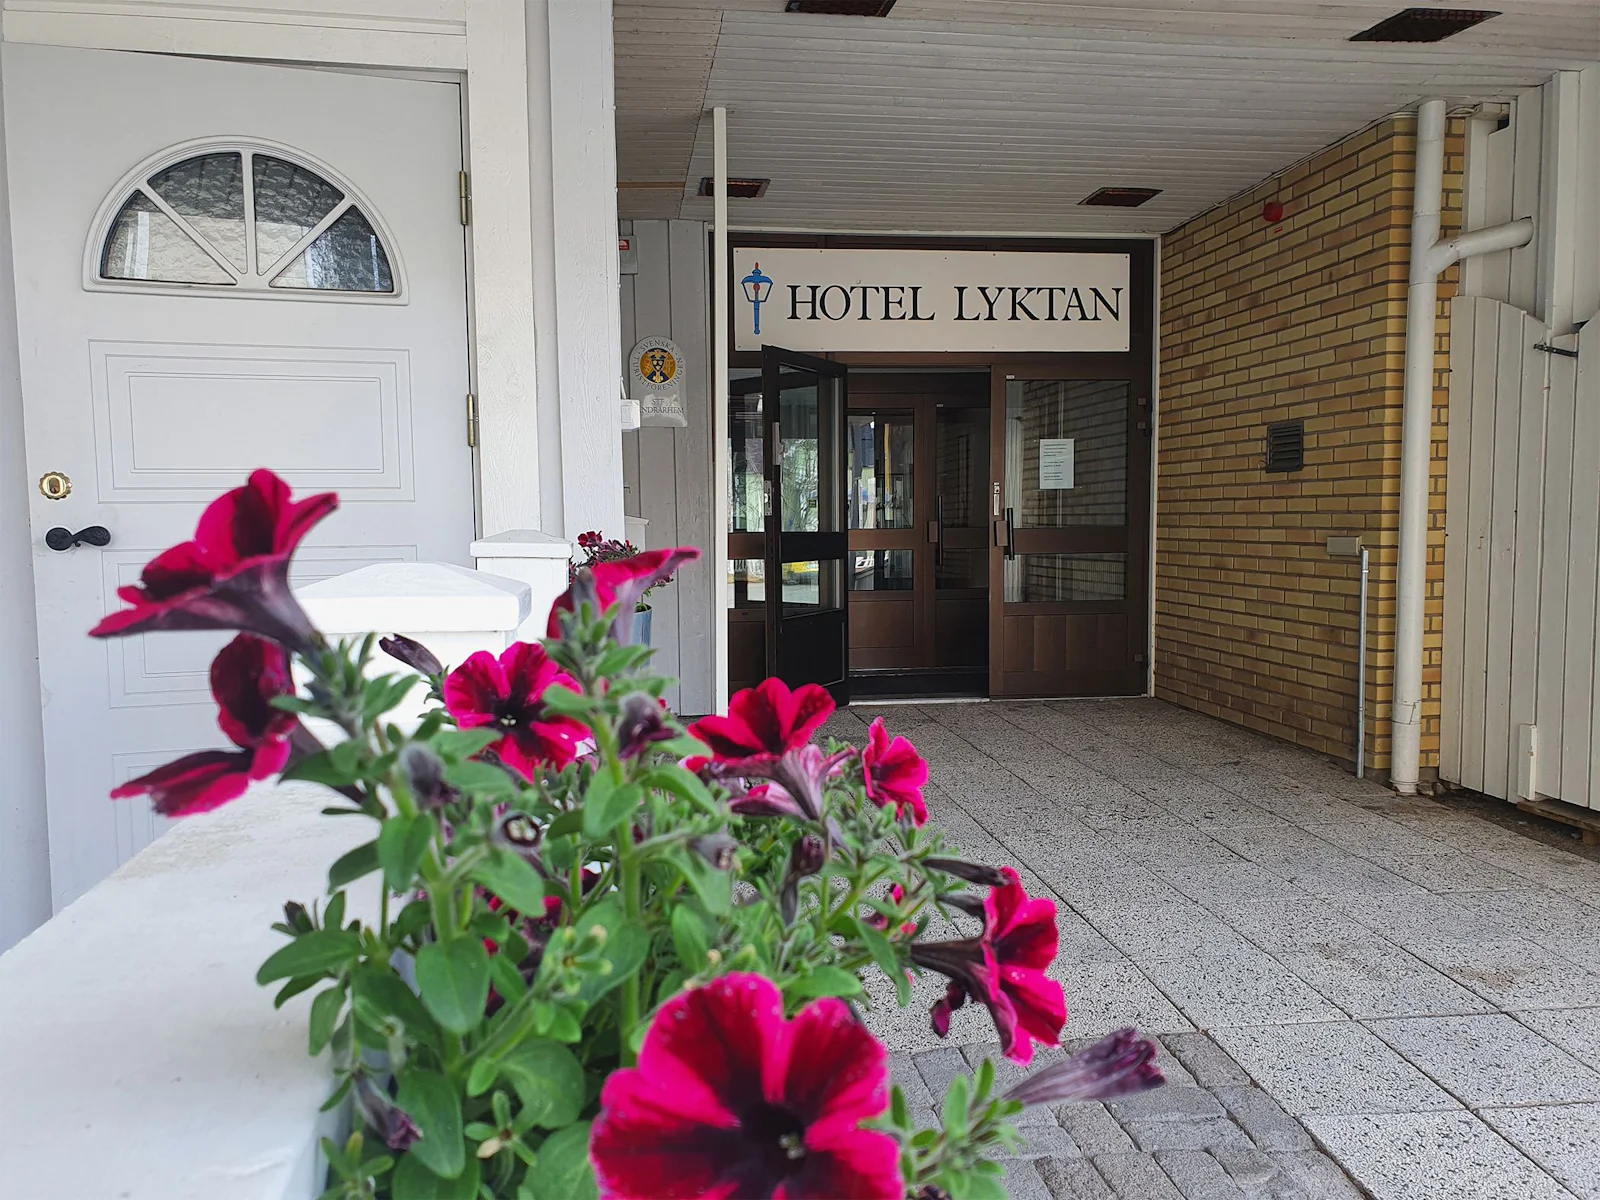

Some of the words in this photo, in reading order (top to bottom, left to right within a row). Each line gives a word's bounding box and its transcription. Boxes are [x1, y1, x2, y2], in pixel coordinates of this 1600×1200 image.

[786, 285, 936, 321] HOTEL
[954, 286, 1124, 322] LYKTAN
[640, 339, 675, 352] SVENSKA
[640, 406, 685, 414] NDRARHEM
